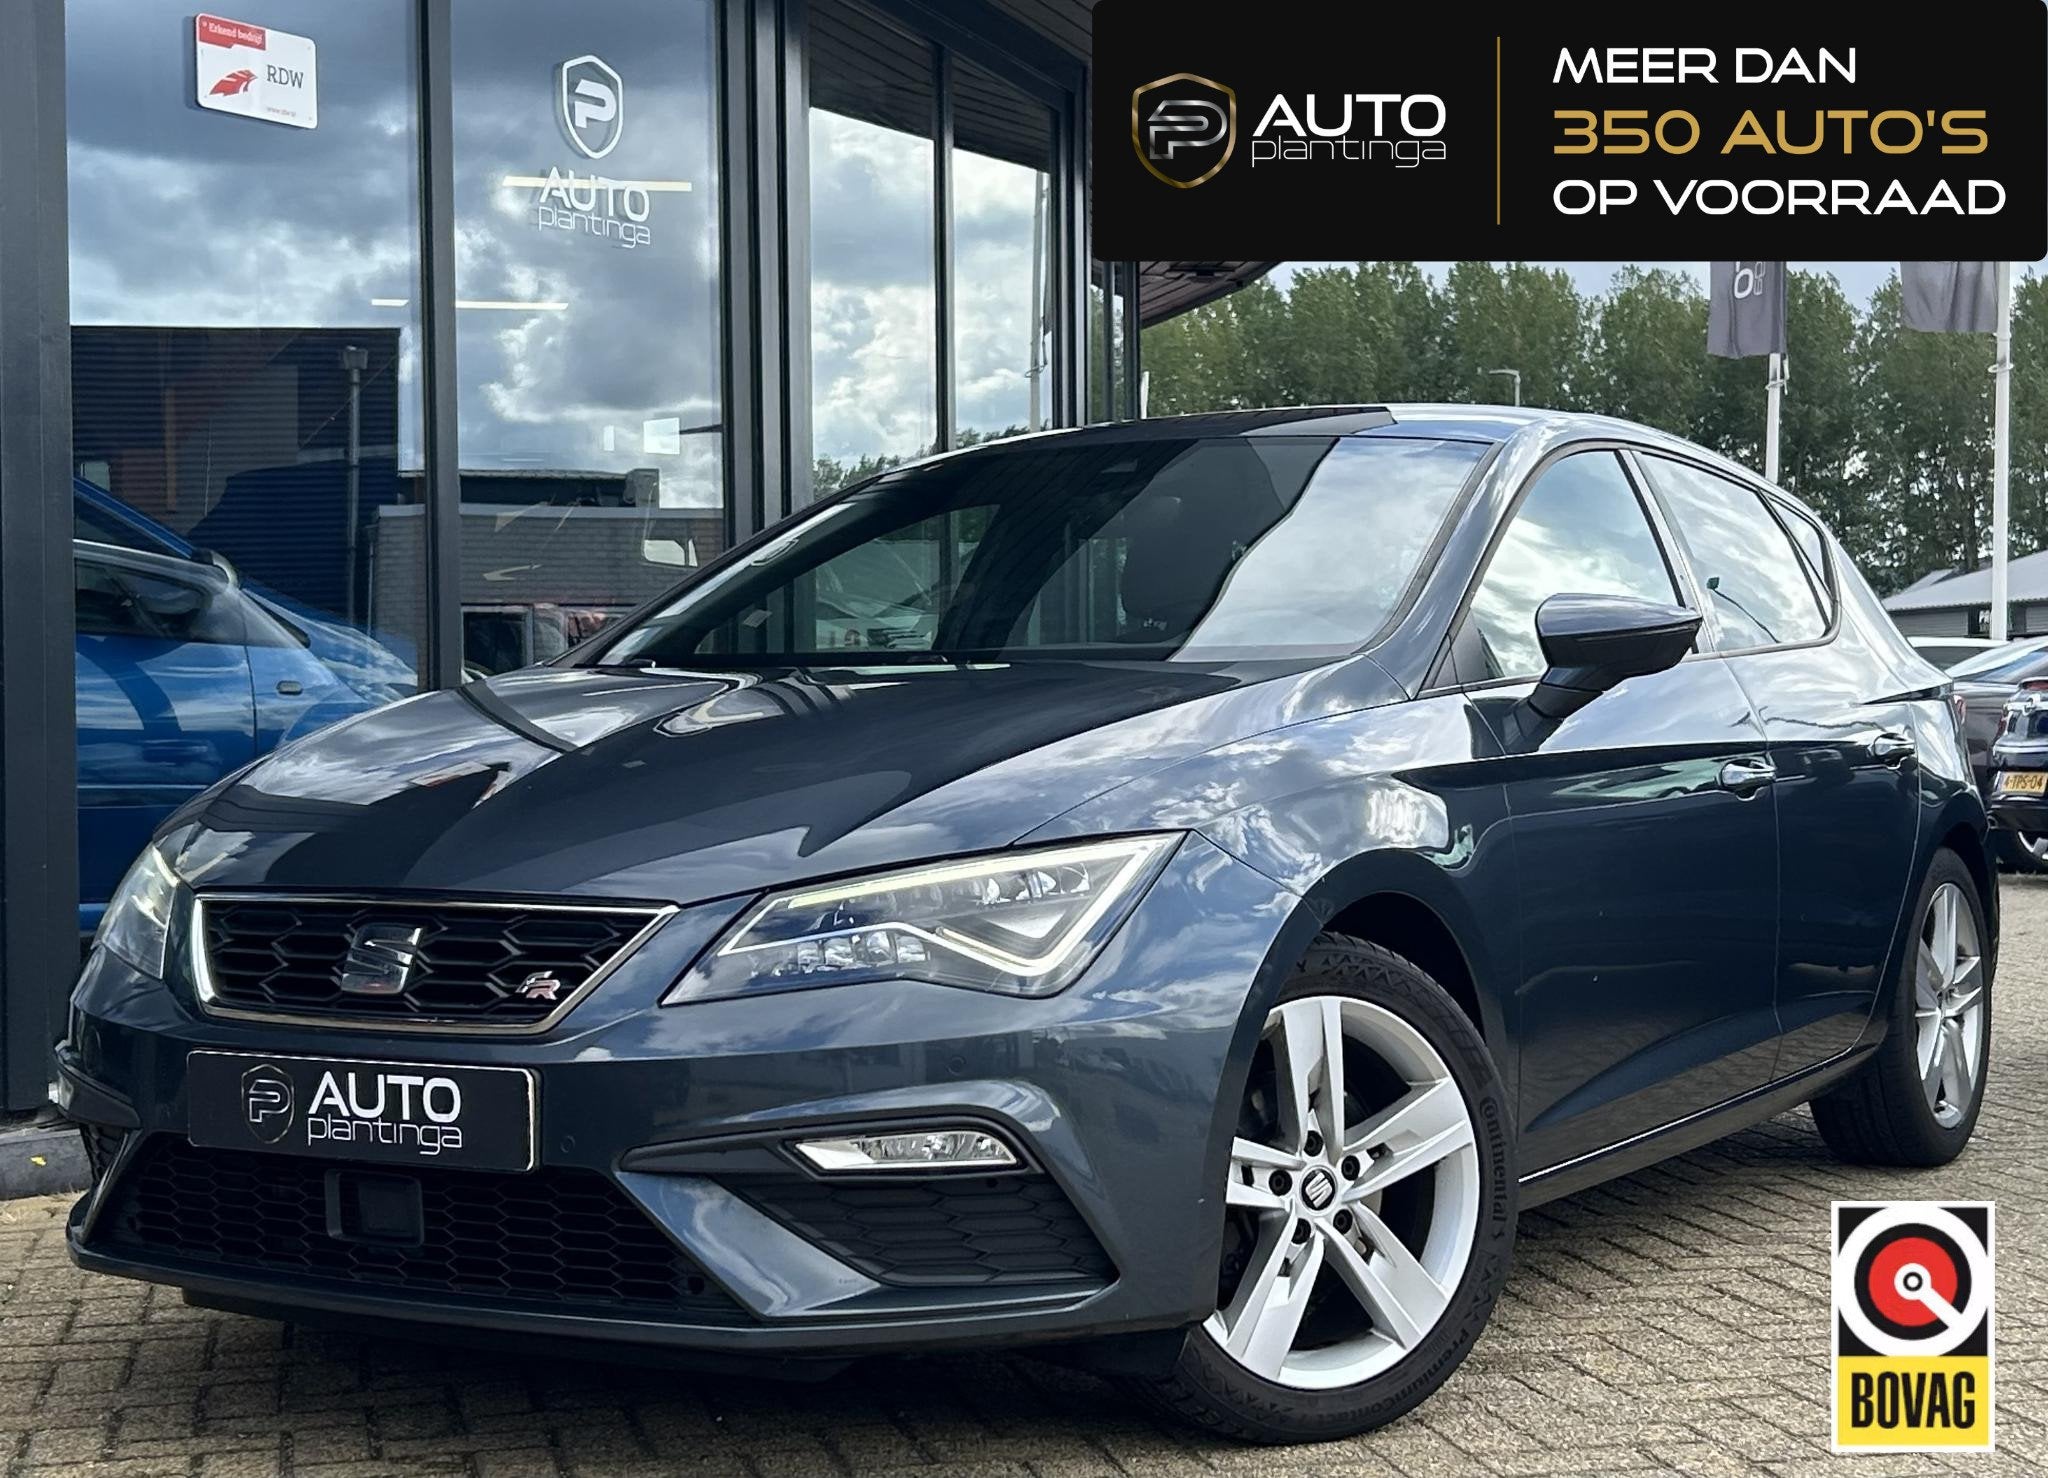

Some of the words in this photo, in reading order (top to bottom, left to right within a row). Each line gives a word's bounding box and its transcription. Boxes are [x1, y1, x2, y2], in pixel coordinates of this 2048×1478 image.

[267, 64, 304, 89] RDW
[539, 166, 650, 222] AUTO
[539, 205, 650, 249] plantinga
[308, 1071, 461, 1123] AUTO
[308, 1113, 462, 1155] plantinga
[1480, 1096, 1507, 1222] Continental
